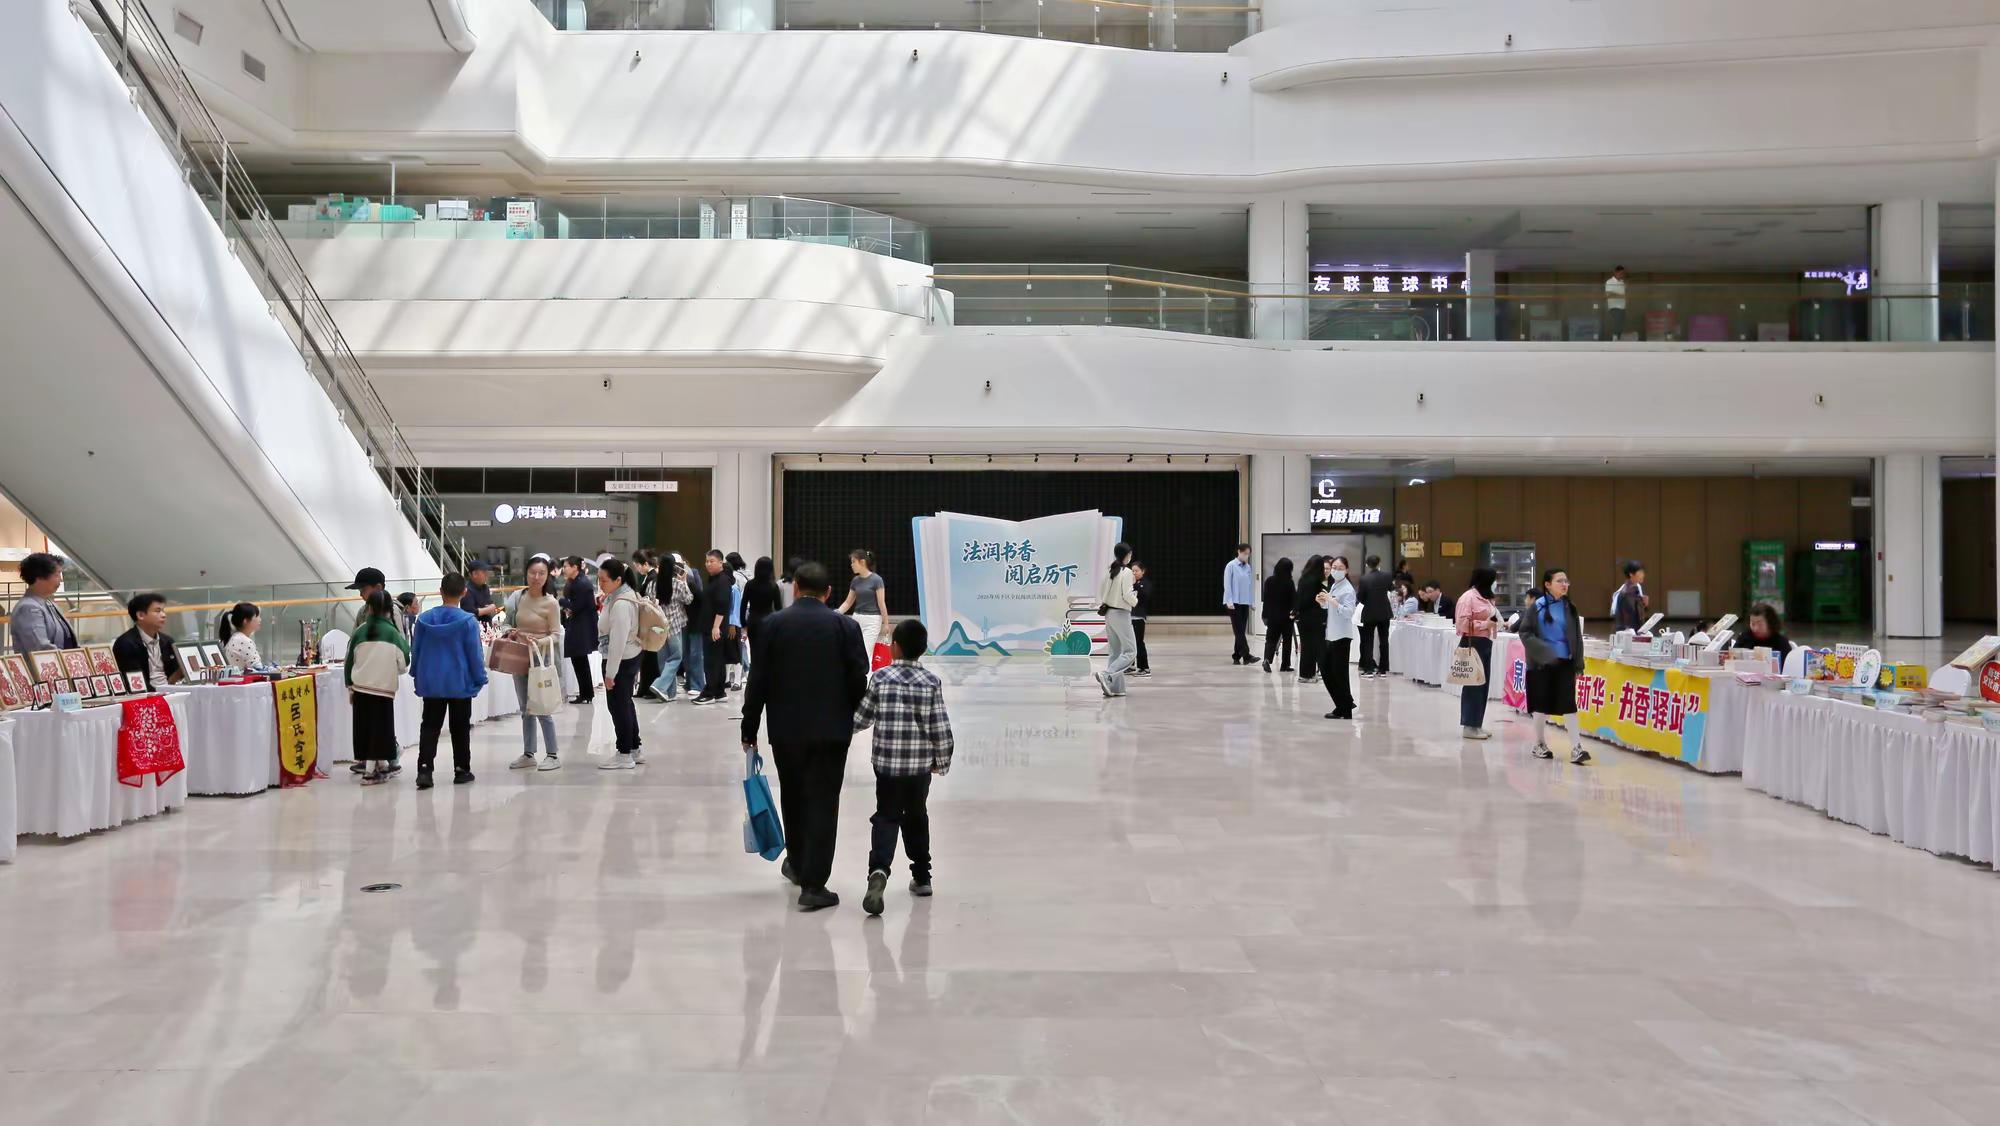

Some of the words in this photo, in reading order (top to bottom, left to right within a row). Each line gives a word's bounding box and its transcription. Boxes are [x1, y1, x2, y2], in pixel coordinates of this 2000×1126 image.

[516, 505, 557, 519] 柯瑞林
[963, 539, 1036, 563] 法润书香
[1004, 564, 1079, 587] 阅启历下
[1513, 659, 1527, 692] 泉
